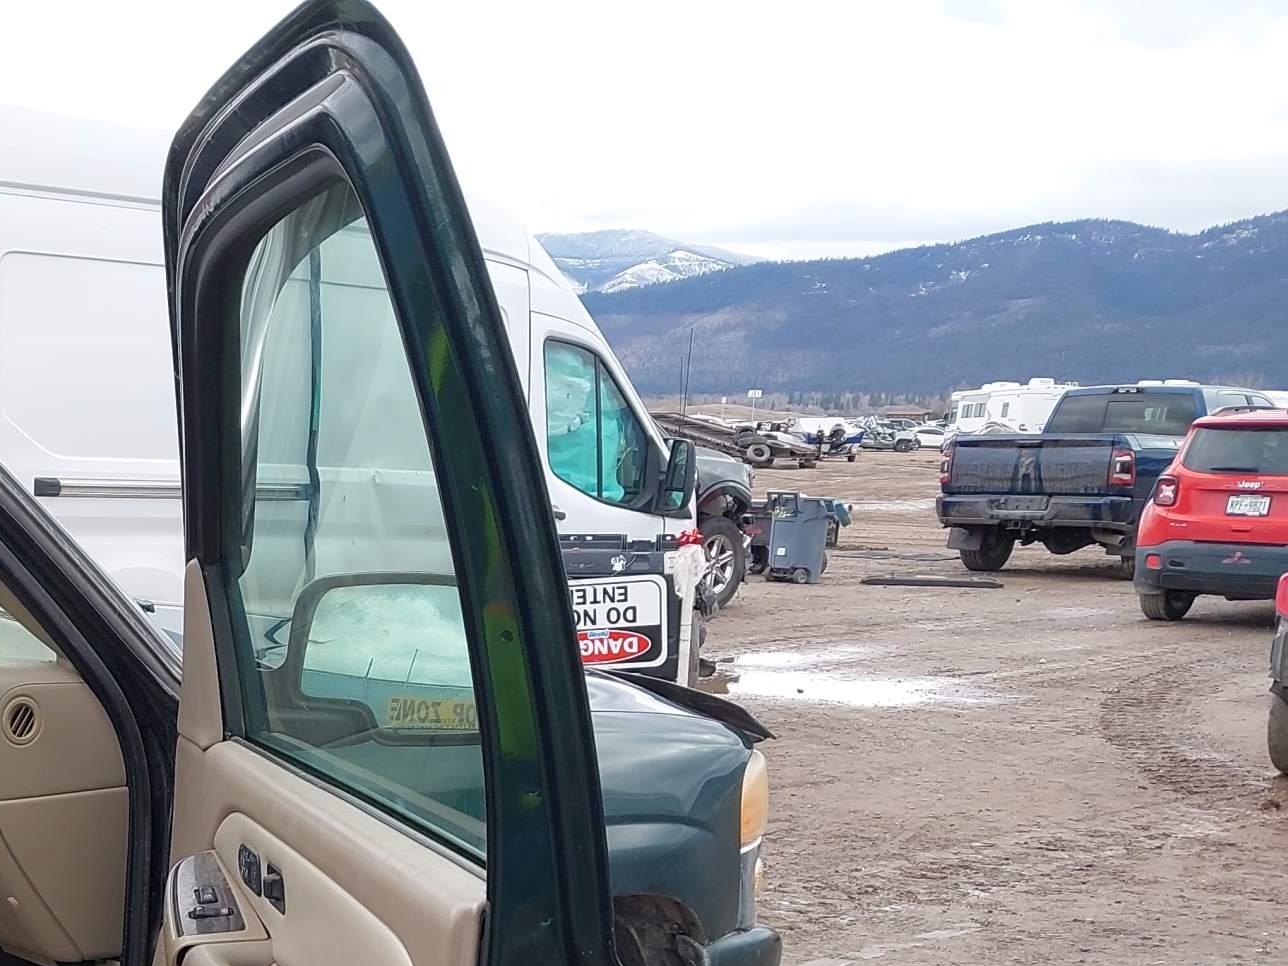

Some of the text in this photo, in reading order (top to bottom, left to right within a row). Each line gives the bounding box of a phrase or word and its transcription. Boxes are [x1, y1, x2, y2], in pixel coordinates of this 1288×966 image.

[1238, 480, 1261, 489] Jeep
[569, 585, 628, 606] ENTE
[606, 606, 637, 624] DO
[579, 637, 639, 656] DANG
